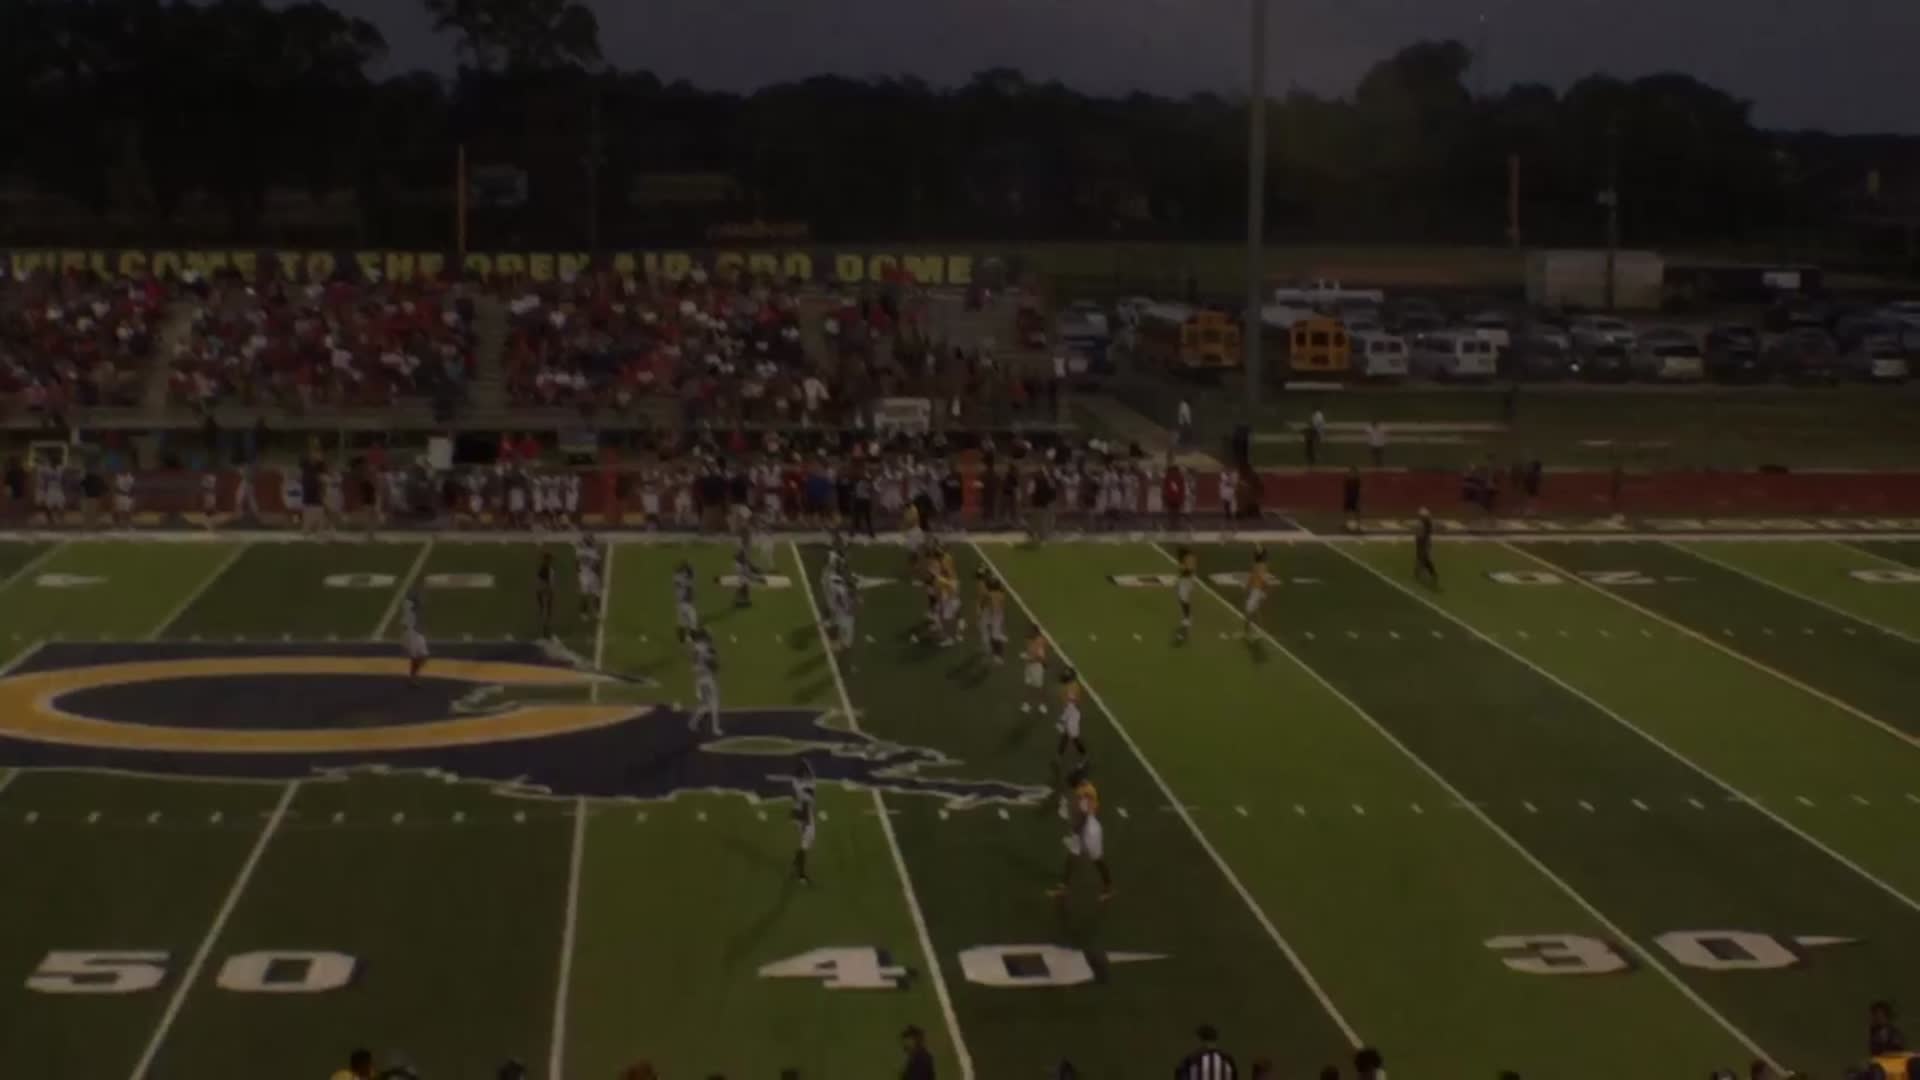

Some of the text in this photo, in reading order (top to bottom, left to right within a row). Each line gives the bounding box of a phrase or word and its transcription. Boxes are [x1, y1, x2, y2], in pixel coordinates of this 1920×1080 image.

[11, 251, 257, 283] WELCOME
[275, 252, 336, 282] TO
[464, 252, 592, 282] OPEN
[836, 254, 974, 285] DOME
